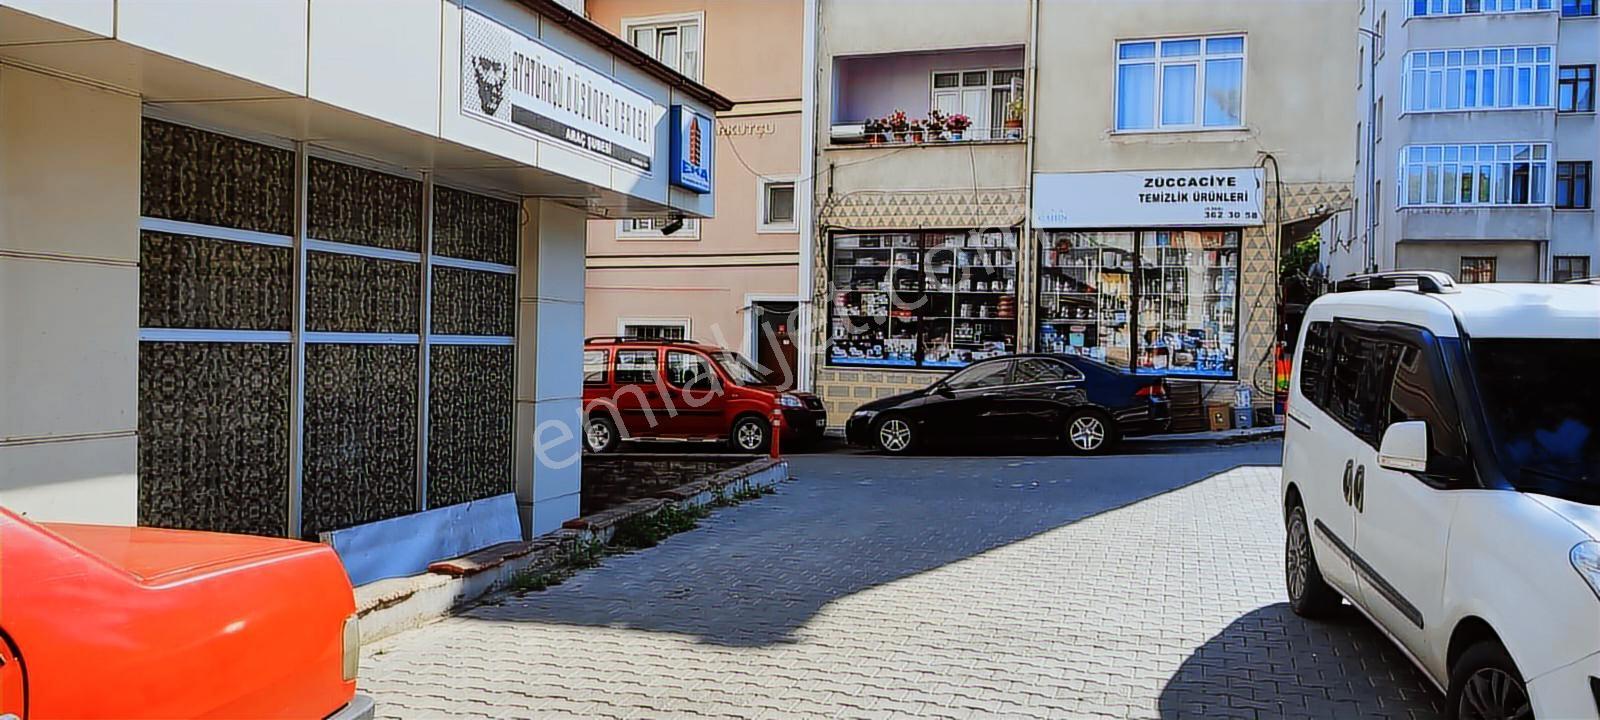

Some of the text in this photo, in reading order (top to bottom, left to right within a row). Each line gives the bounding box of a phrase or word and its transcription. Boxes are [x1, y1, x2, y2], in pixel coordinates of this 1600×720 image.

[1143, 175, 1237, 188] ZÜCCACİYE
[1138, 190, 1249, 203] TEMİZLİK ÜRÜNLERİ
[1228, 211, 1241, 219] 30
